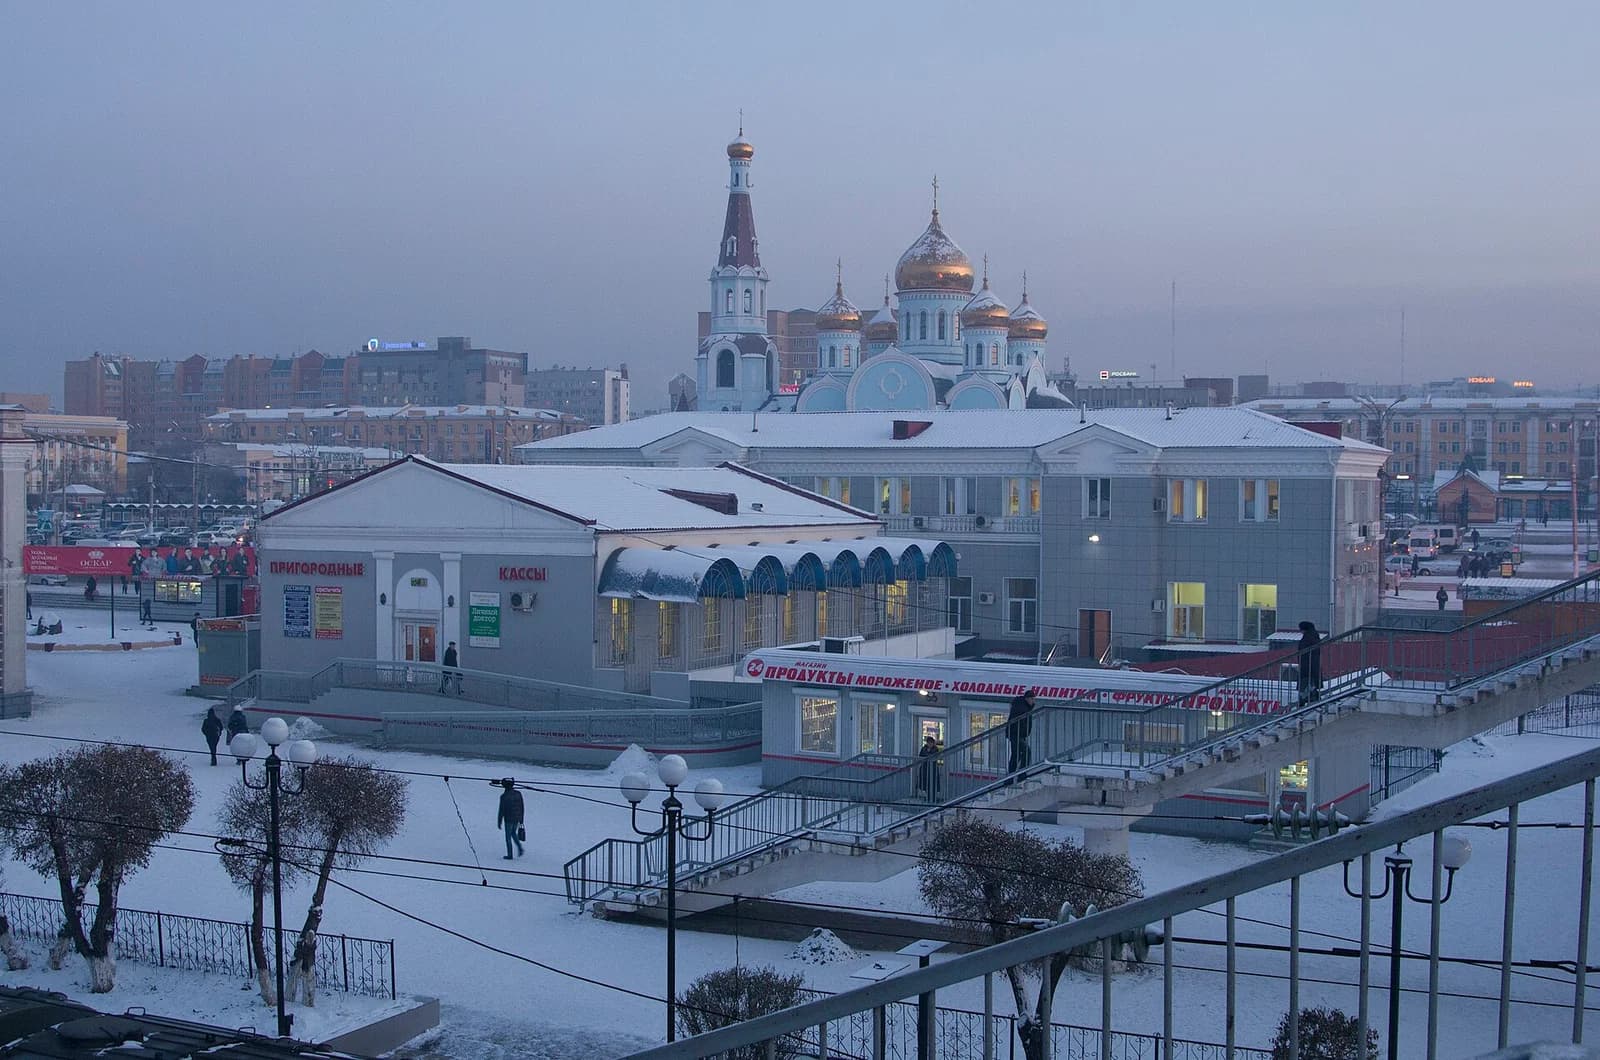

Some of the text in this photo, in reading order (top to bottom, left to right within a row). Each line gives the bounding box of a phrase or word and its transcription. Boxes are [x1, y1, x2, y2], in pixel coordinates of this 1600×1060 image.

[270, 561, 547, 581] ПРИГОРОДНЫЕ КАССЫ
[748, 662, 763, 672] 24
[765, 665, 854, 685] ПРОДУКТЫ
[795, 661, 828, 669] МАГАЗИН
[856, 674, 943, 690] МОРОЖЕНОЕ
[951, 681, 1027, 696] ХОЛОДНЫЕ
[1030, 685, 1097, 700] НАПИТКИ
